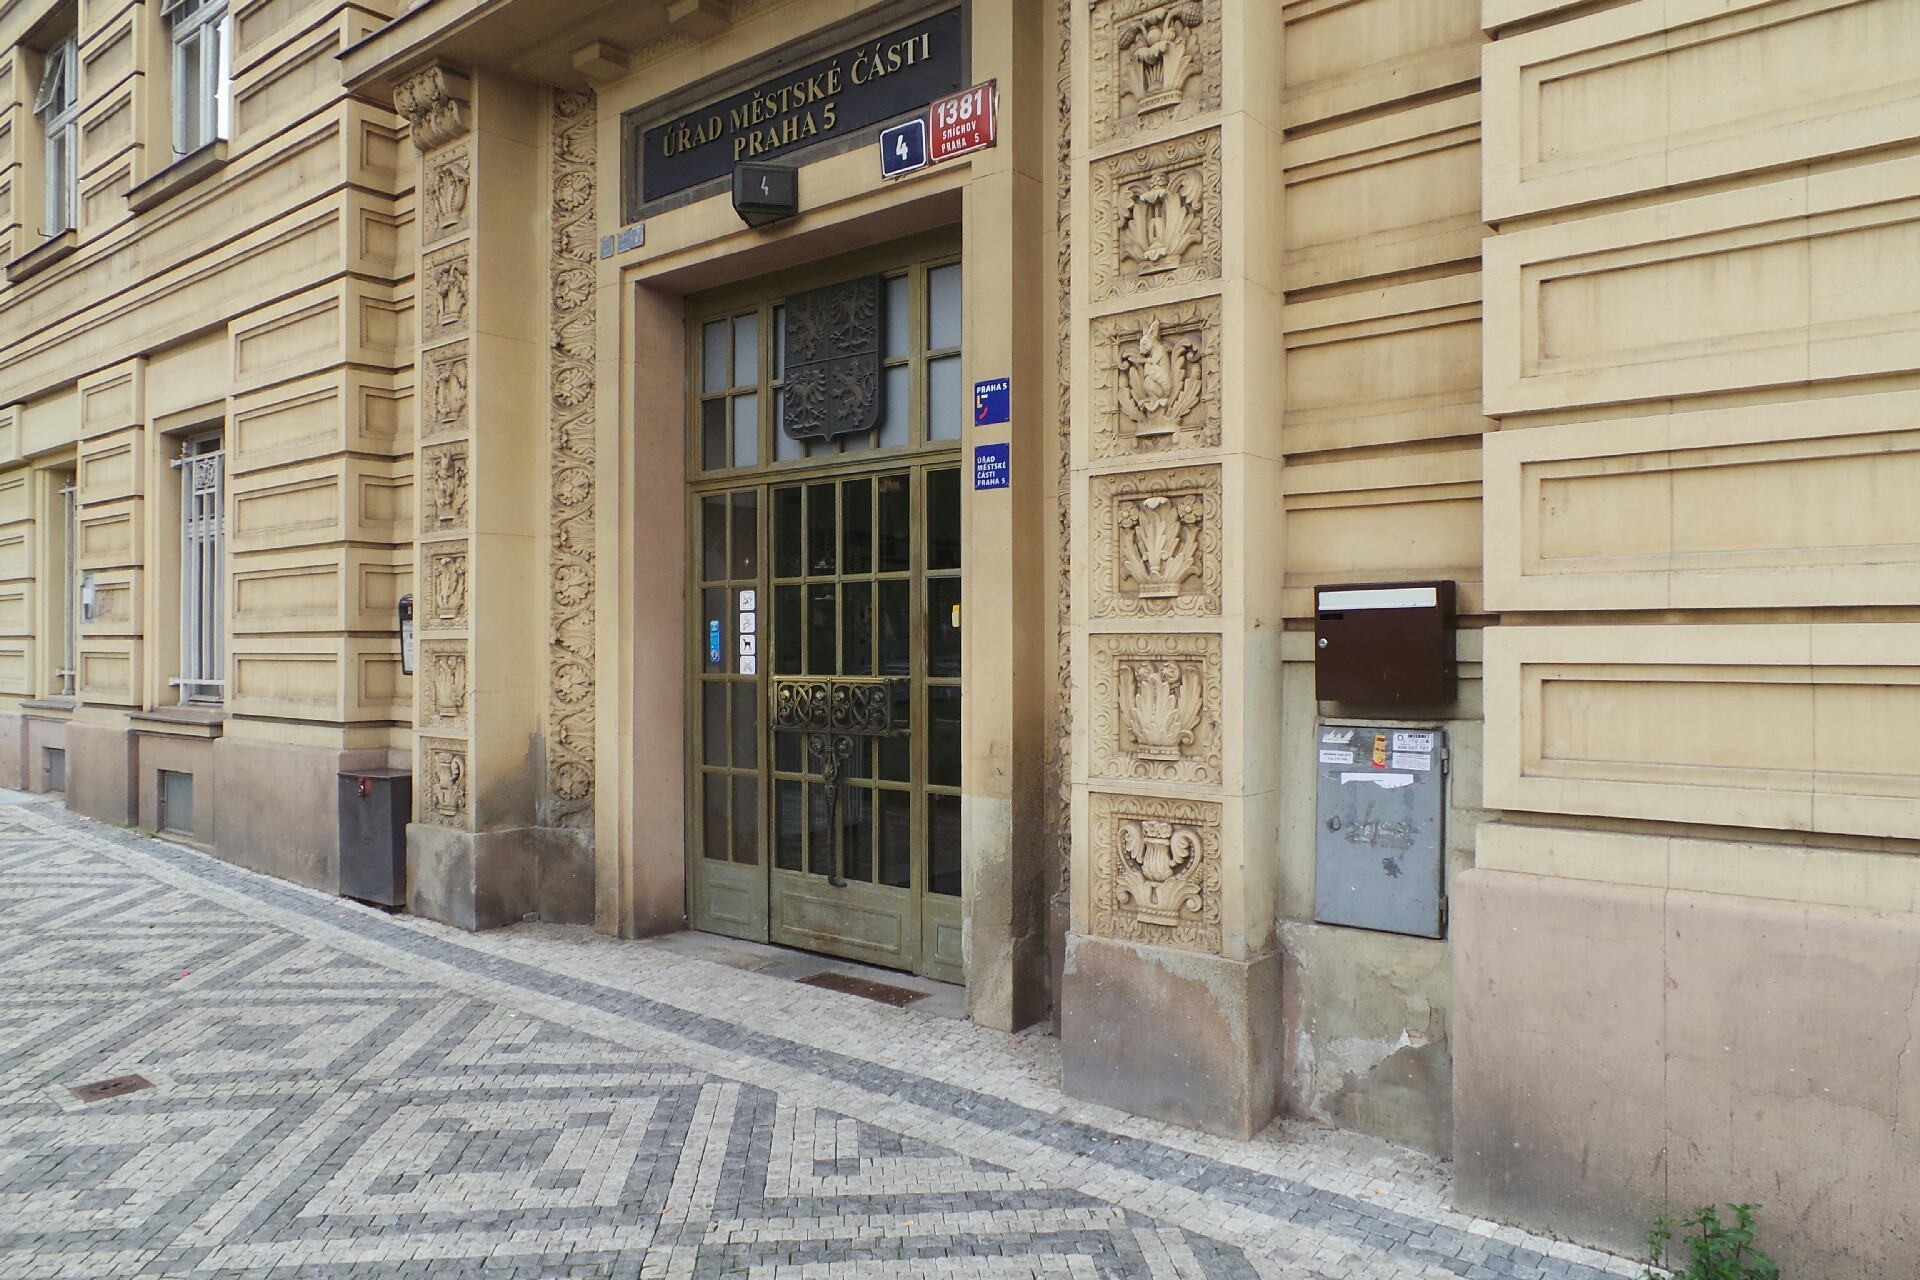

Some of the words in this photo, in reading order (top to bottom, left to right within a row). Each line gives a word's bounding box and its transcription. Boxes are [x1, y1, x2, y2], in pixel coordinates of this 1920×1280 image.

[663, 116, 723, 157] ÚŘAD
[730, 59, 842, 133] MĚSTSKÉ
[851, 32, 930, 85] ČÁSTI
[938, 89, 983, 128] 1381
[734, 111, 818, 161] PRAHA
[823, 102, 836, 130] 5
[942, 119, 977, 140] SMÍCHOV
[895, 134, 909, 160] 4
[941, 137, 967, 154] PRAHA
[974, 132, 980, 143] 5
[760, 175, 769, 196] 4
[976, 384, 1001, 394] PRAHA
[978, 478, 1000, 486] PRAHA
